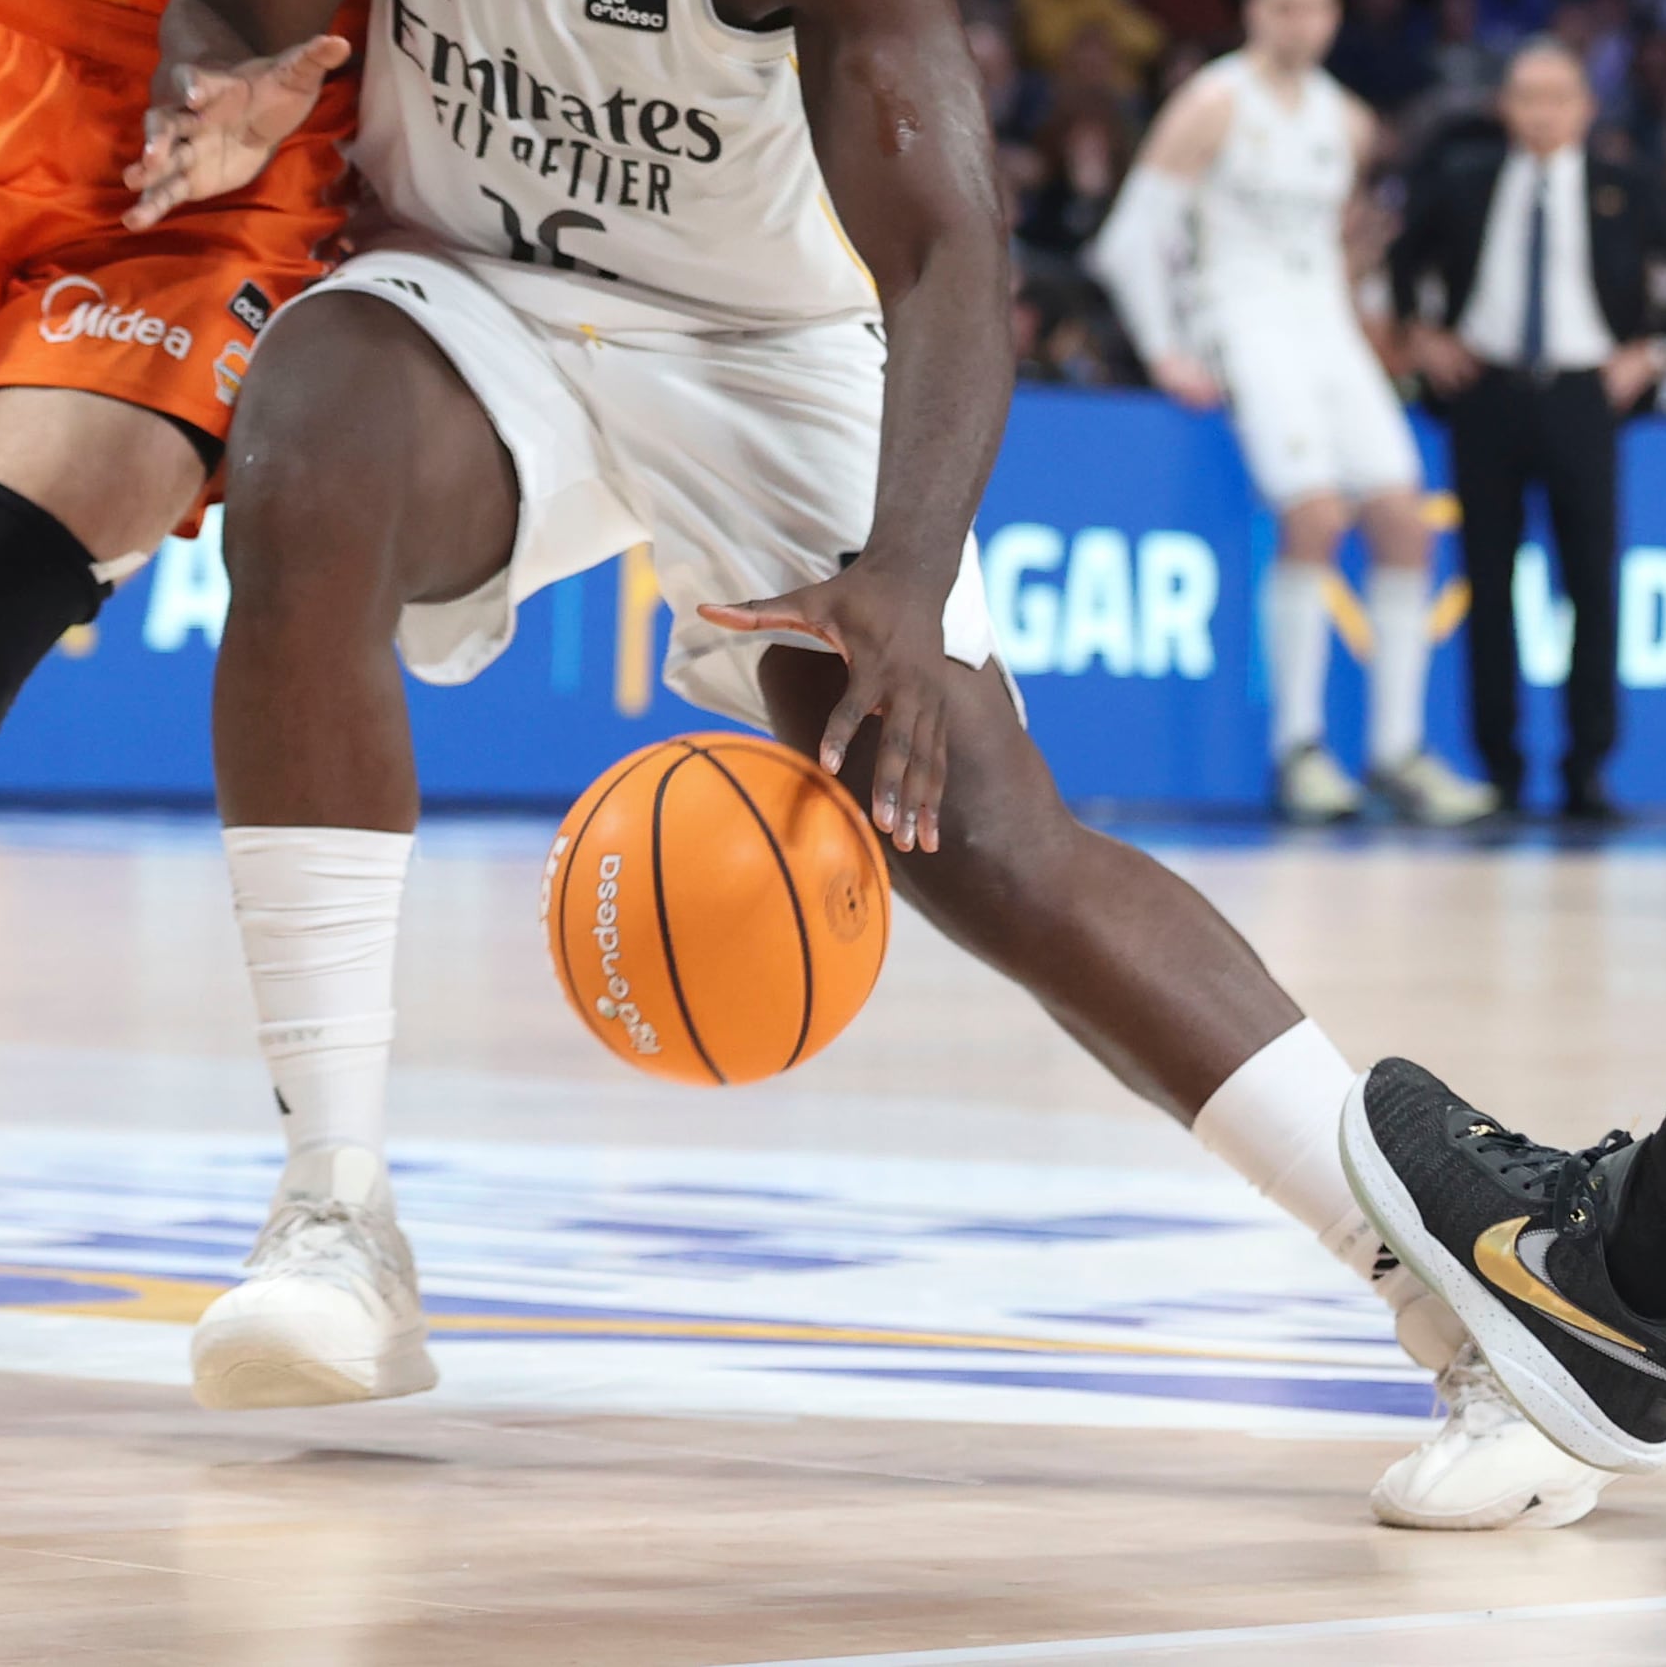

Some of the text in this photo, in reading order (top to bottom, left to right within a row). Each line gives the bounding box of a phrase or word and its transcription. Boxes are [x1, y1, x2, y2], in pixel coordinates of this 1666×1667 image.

[590, 2, 665, 28] endesa
[51, 300, 192, 360] Midea
[592, 853, 630, 1000] endesa
